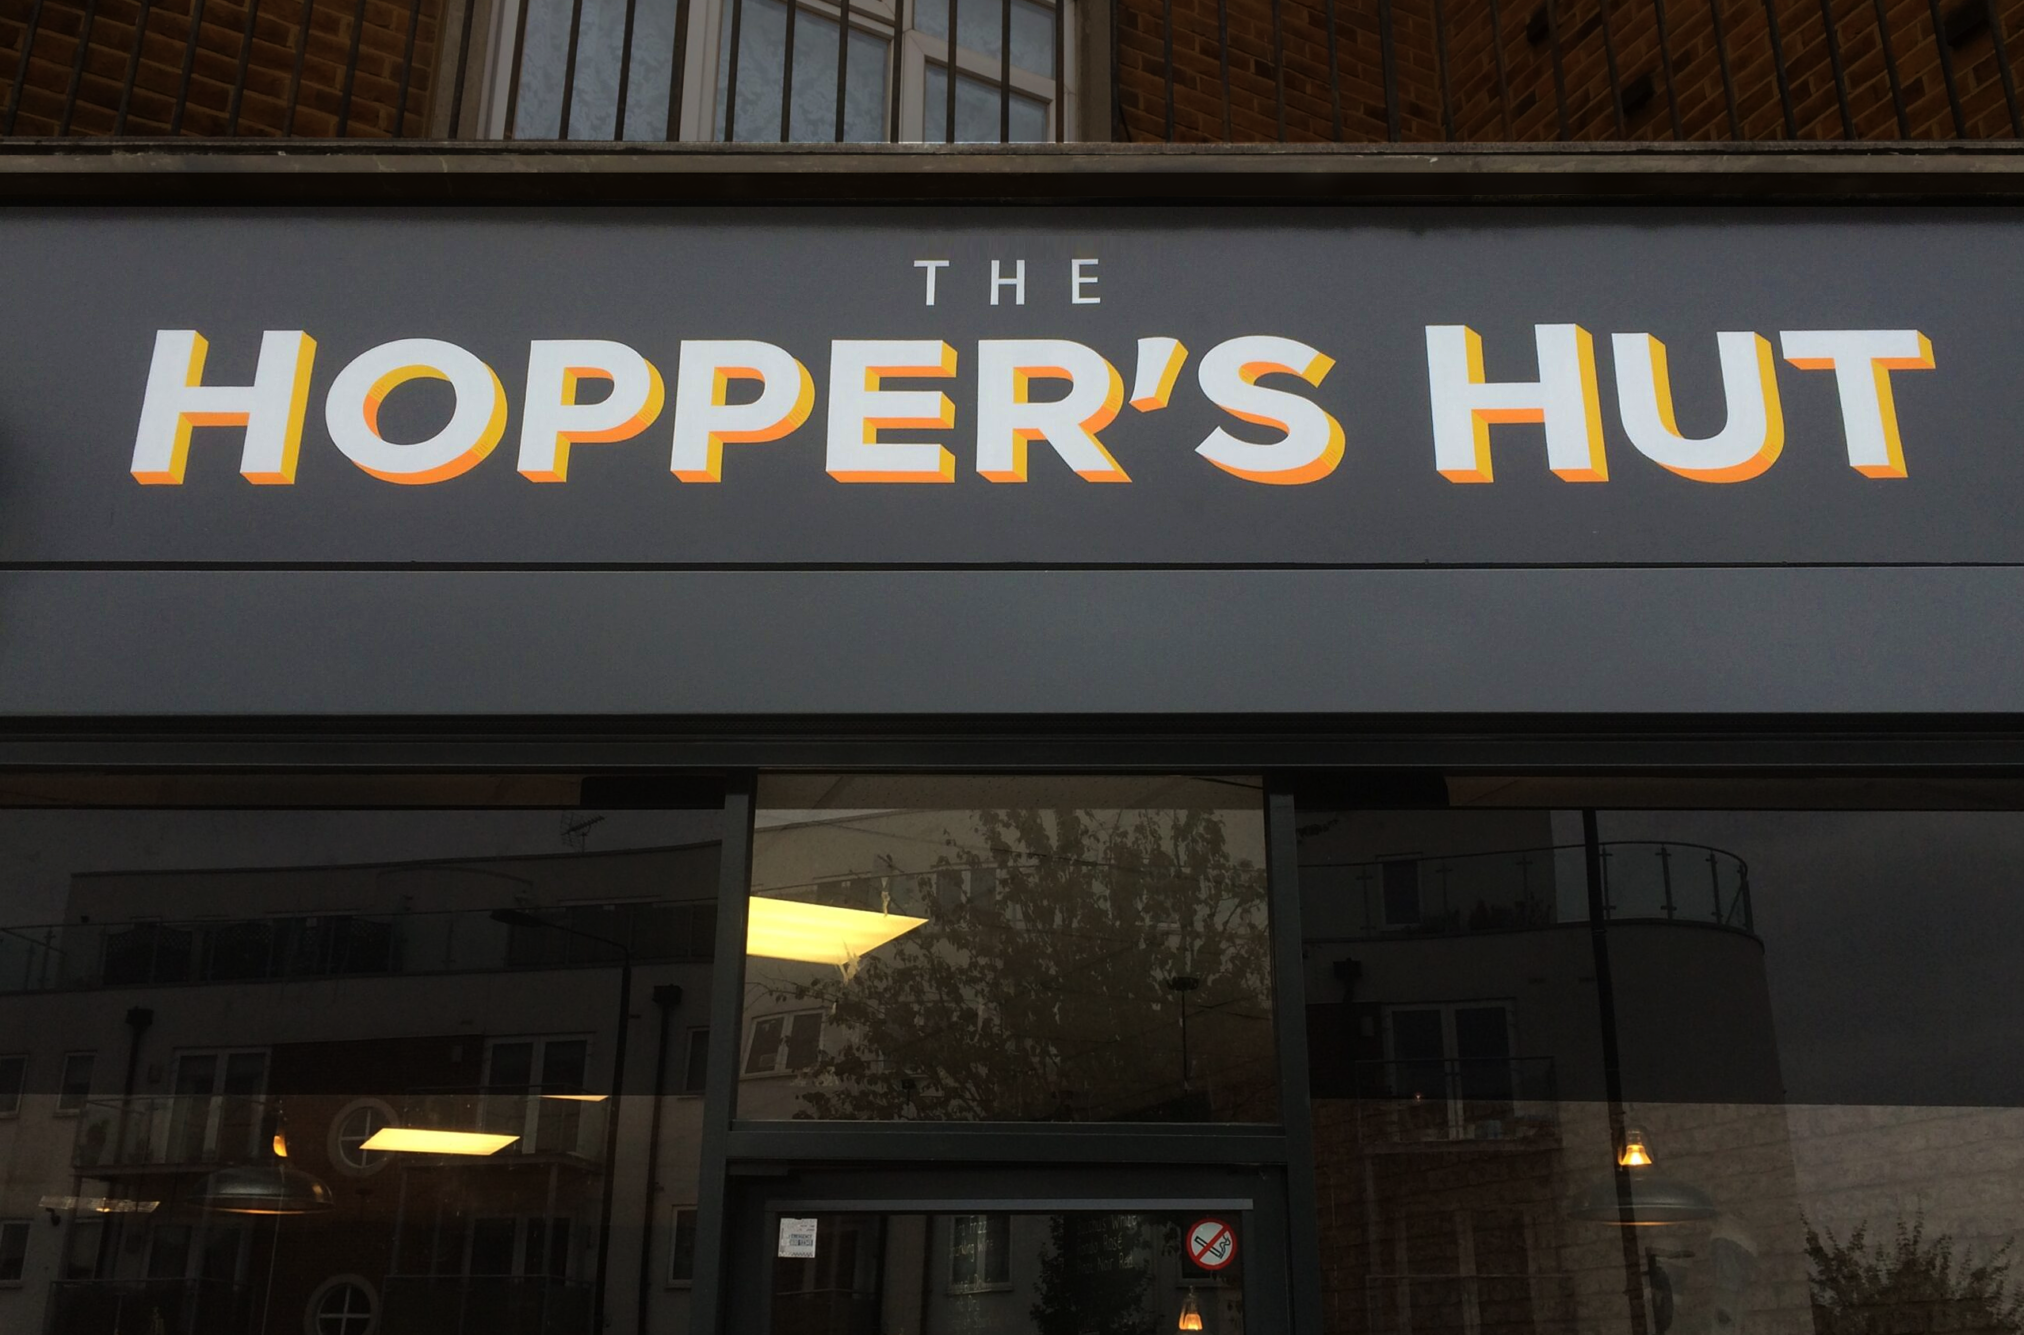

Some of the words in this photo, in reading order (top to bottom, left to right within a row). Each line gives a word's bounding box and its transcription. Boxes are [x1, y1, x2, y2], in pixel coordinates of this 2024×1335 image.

[914, 258, 1101, 306] THE
[130, 329, 1346, 486] HOPPER'S
[1425, 322, 1937, 484] HUT
